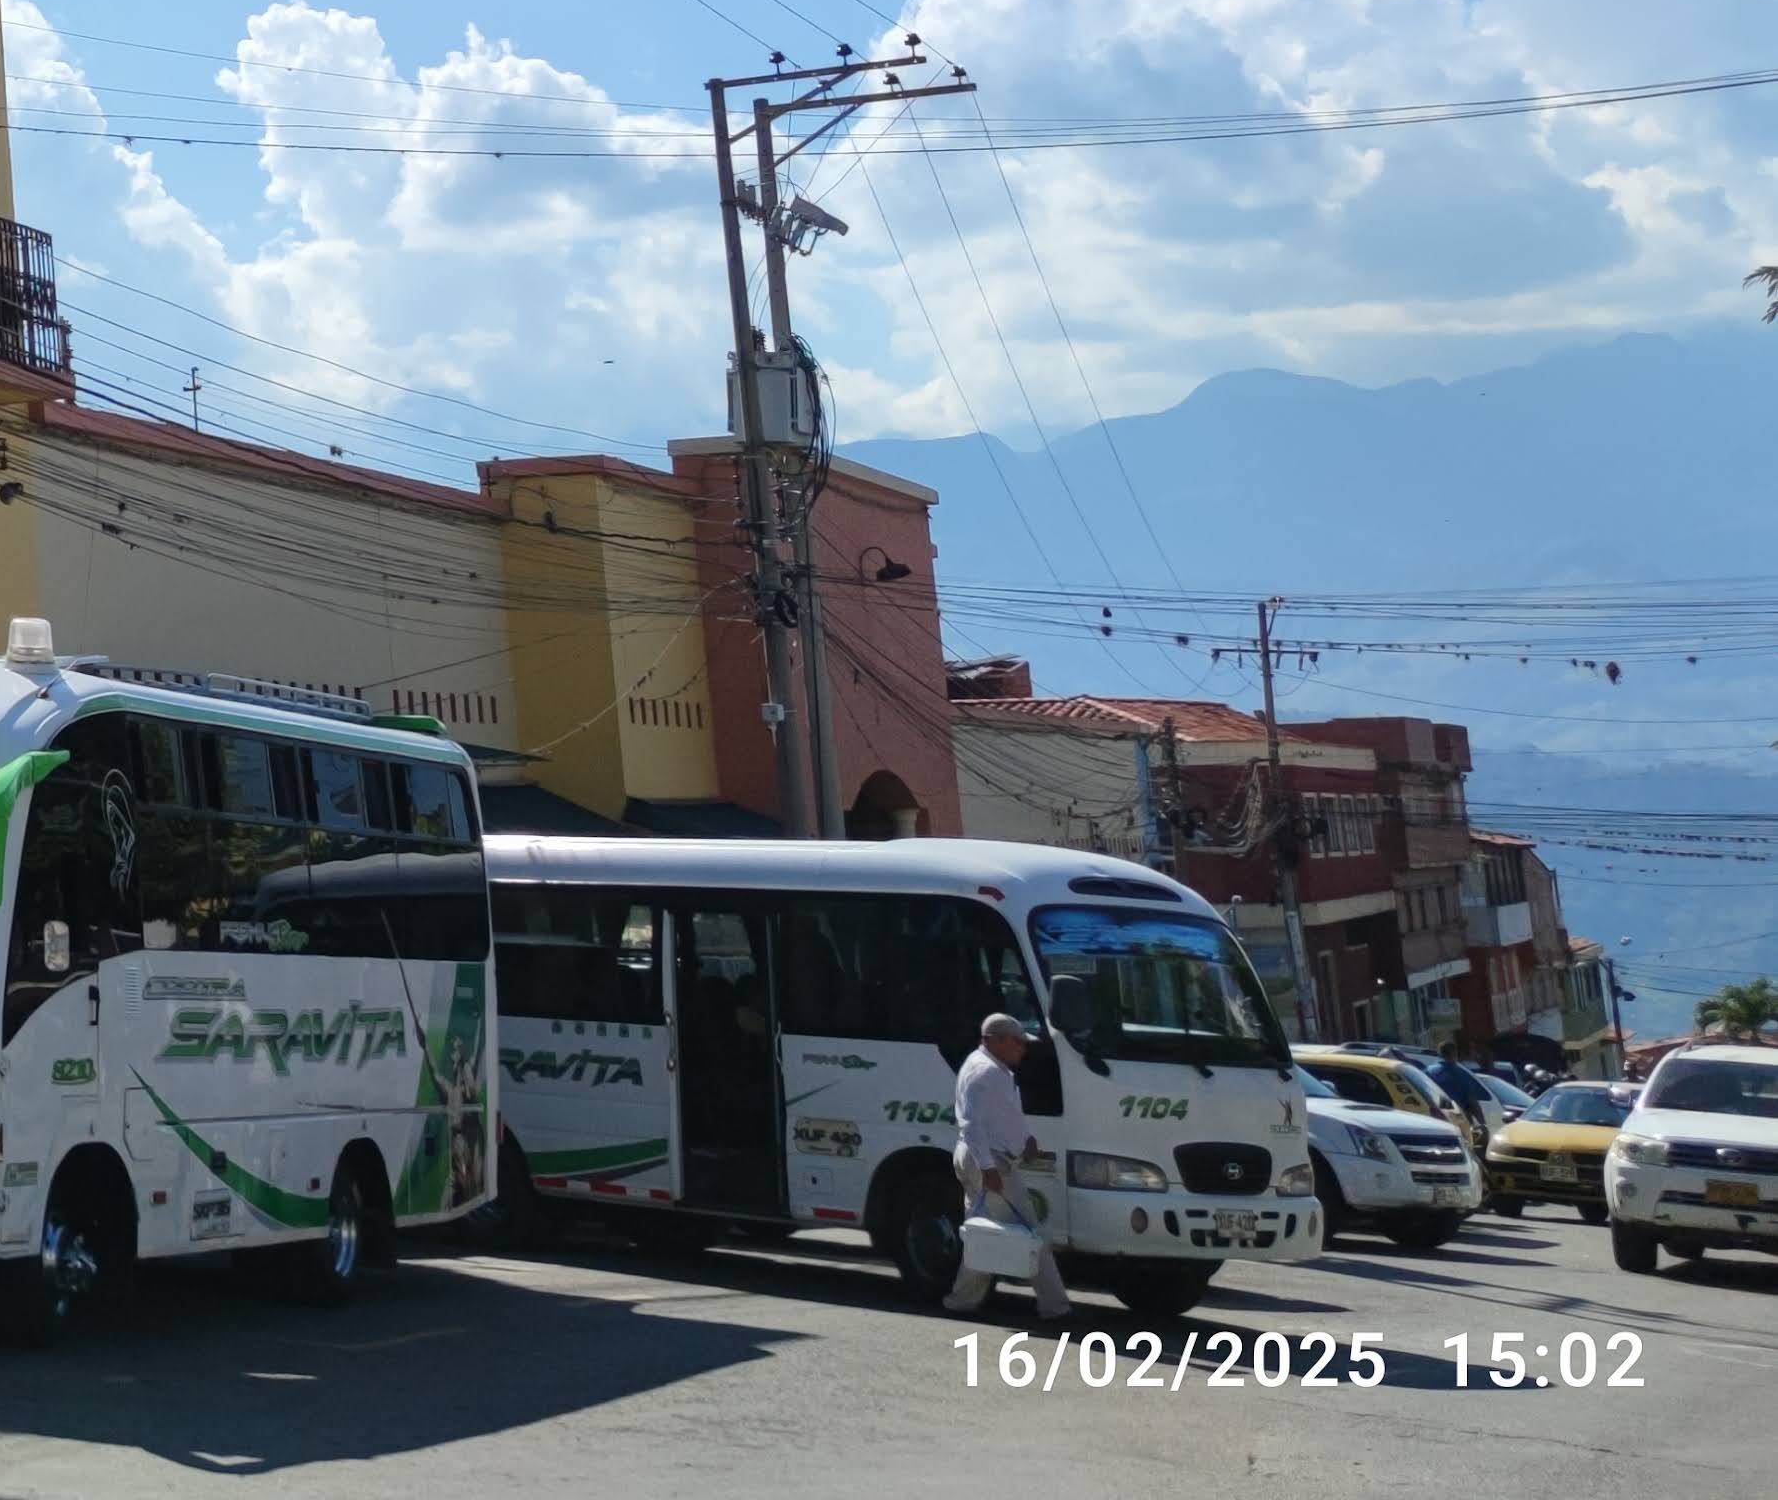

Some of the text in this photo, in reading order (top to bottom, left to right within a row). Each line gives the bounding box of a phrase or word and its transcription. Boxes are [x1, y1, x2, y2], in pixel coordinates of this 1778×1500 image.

[498, 1048, 643, 1087] RAVITA
[883, 1100, 957, 1126] 1104
[1119, 1095, 1190, 1121] 1104
